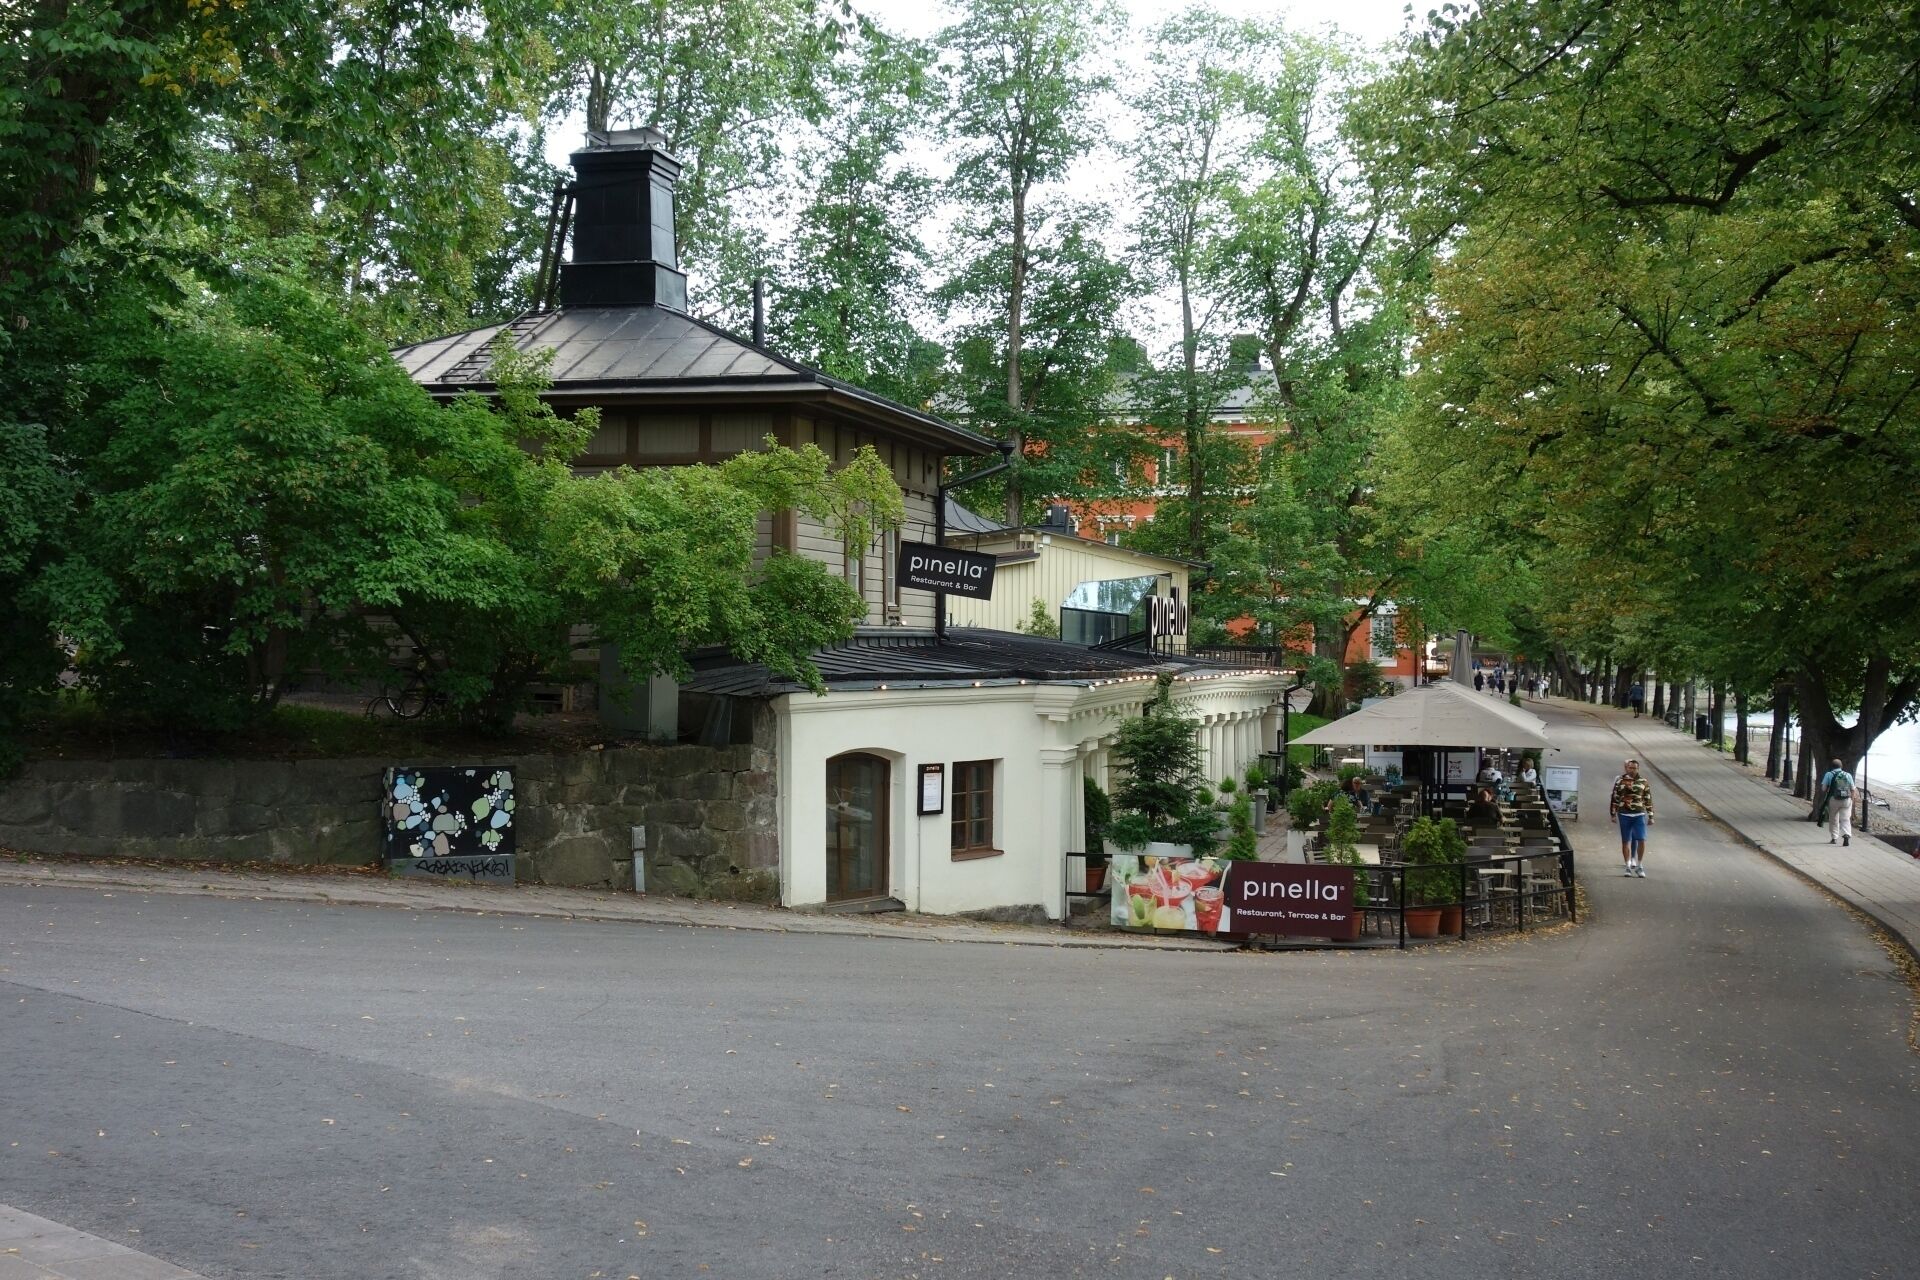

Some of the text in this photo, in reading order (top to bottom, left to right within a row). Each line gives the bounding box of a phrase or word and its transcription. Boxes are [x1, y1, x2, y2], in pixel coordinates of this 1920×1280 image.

[911, 556, 982, 578] pinella
[911, 575, 953, 587] Restaurant
[1152, 587, 1187, 649] pinella
[1244, 880, 1337, 900] pinella
[1237, 908, 1285, 919] Restaurant,
[1288, 911, 1319, 920] Terrace
[1330, 913, 1346, 921] Bar
